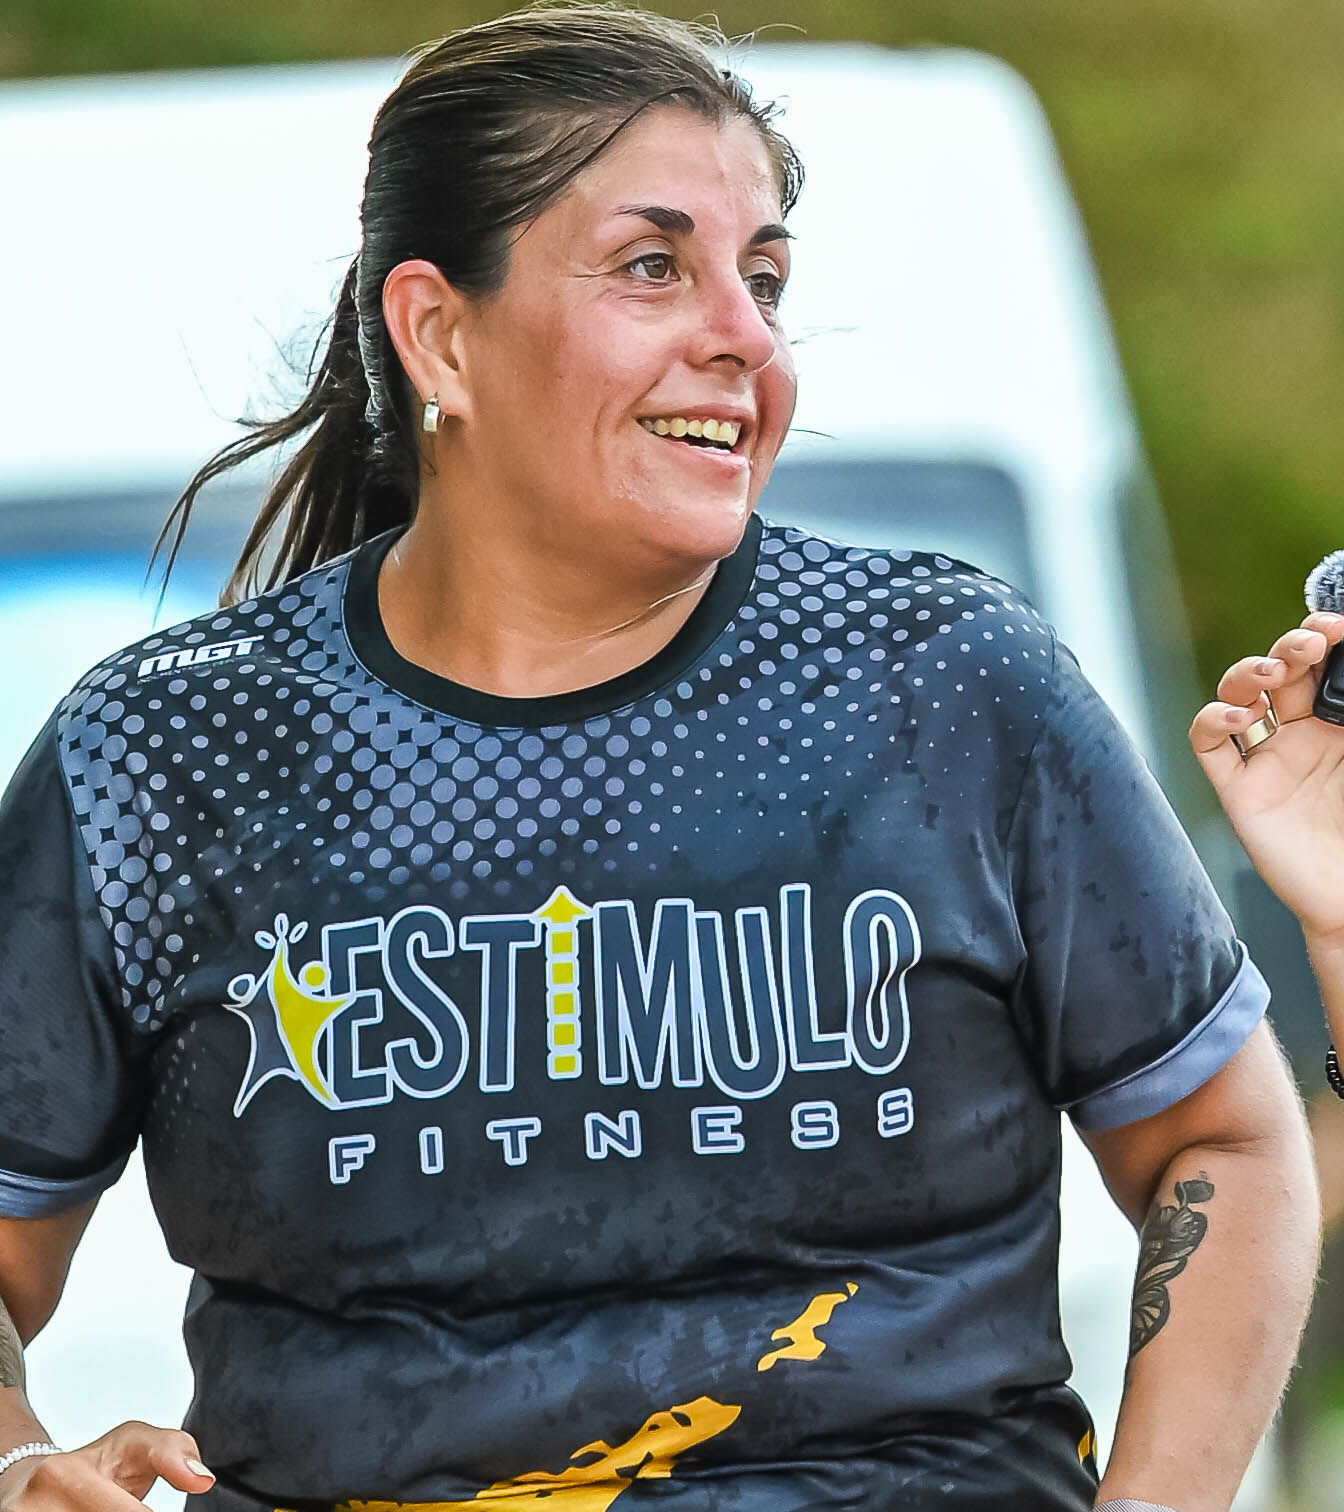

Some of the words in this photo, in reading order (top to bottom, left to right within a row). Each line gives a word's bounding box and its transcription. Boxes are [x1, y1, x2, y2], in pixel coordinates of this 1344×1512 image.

[138, 635, 264, 677] MGT
[322, 883, 922, 1110] ESTIMULO
[329, 1087, 914, 1184] FITNESS
